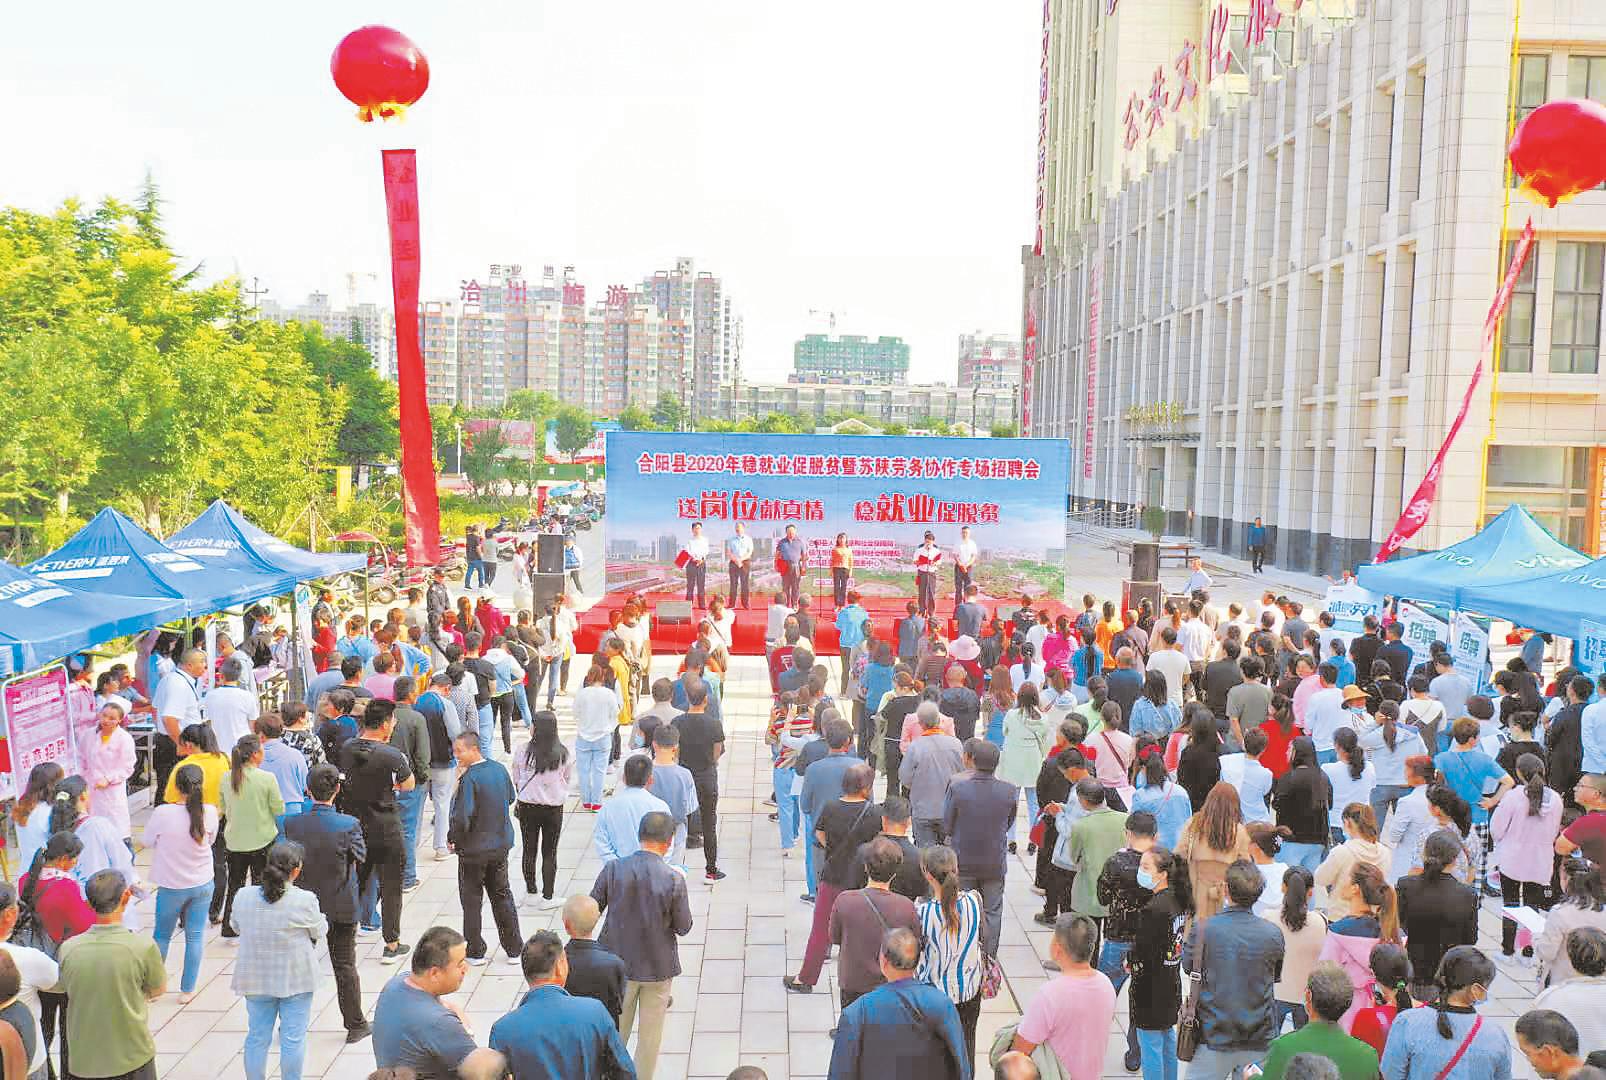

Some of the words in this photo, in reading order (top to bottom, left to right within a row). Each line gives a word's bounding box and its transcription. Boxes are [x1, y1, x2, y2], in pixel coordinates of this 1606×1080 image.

[460, 279, 628, 306] 洽川旅游
[638, 453, 1040, 479] 合阳县2020年稳就业促脱贫暨苏陕劳务协作专场招聘会
[678, 490, 825, 521] 送岗位献真情
[854, 492, 1000, 523] 稳就业促脱贫
[1409, 621, 1437, 645] 招聘
[1460, 631, 1480, 657] 招聘
